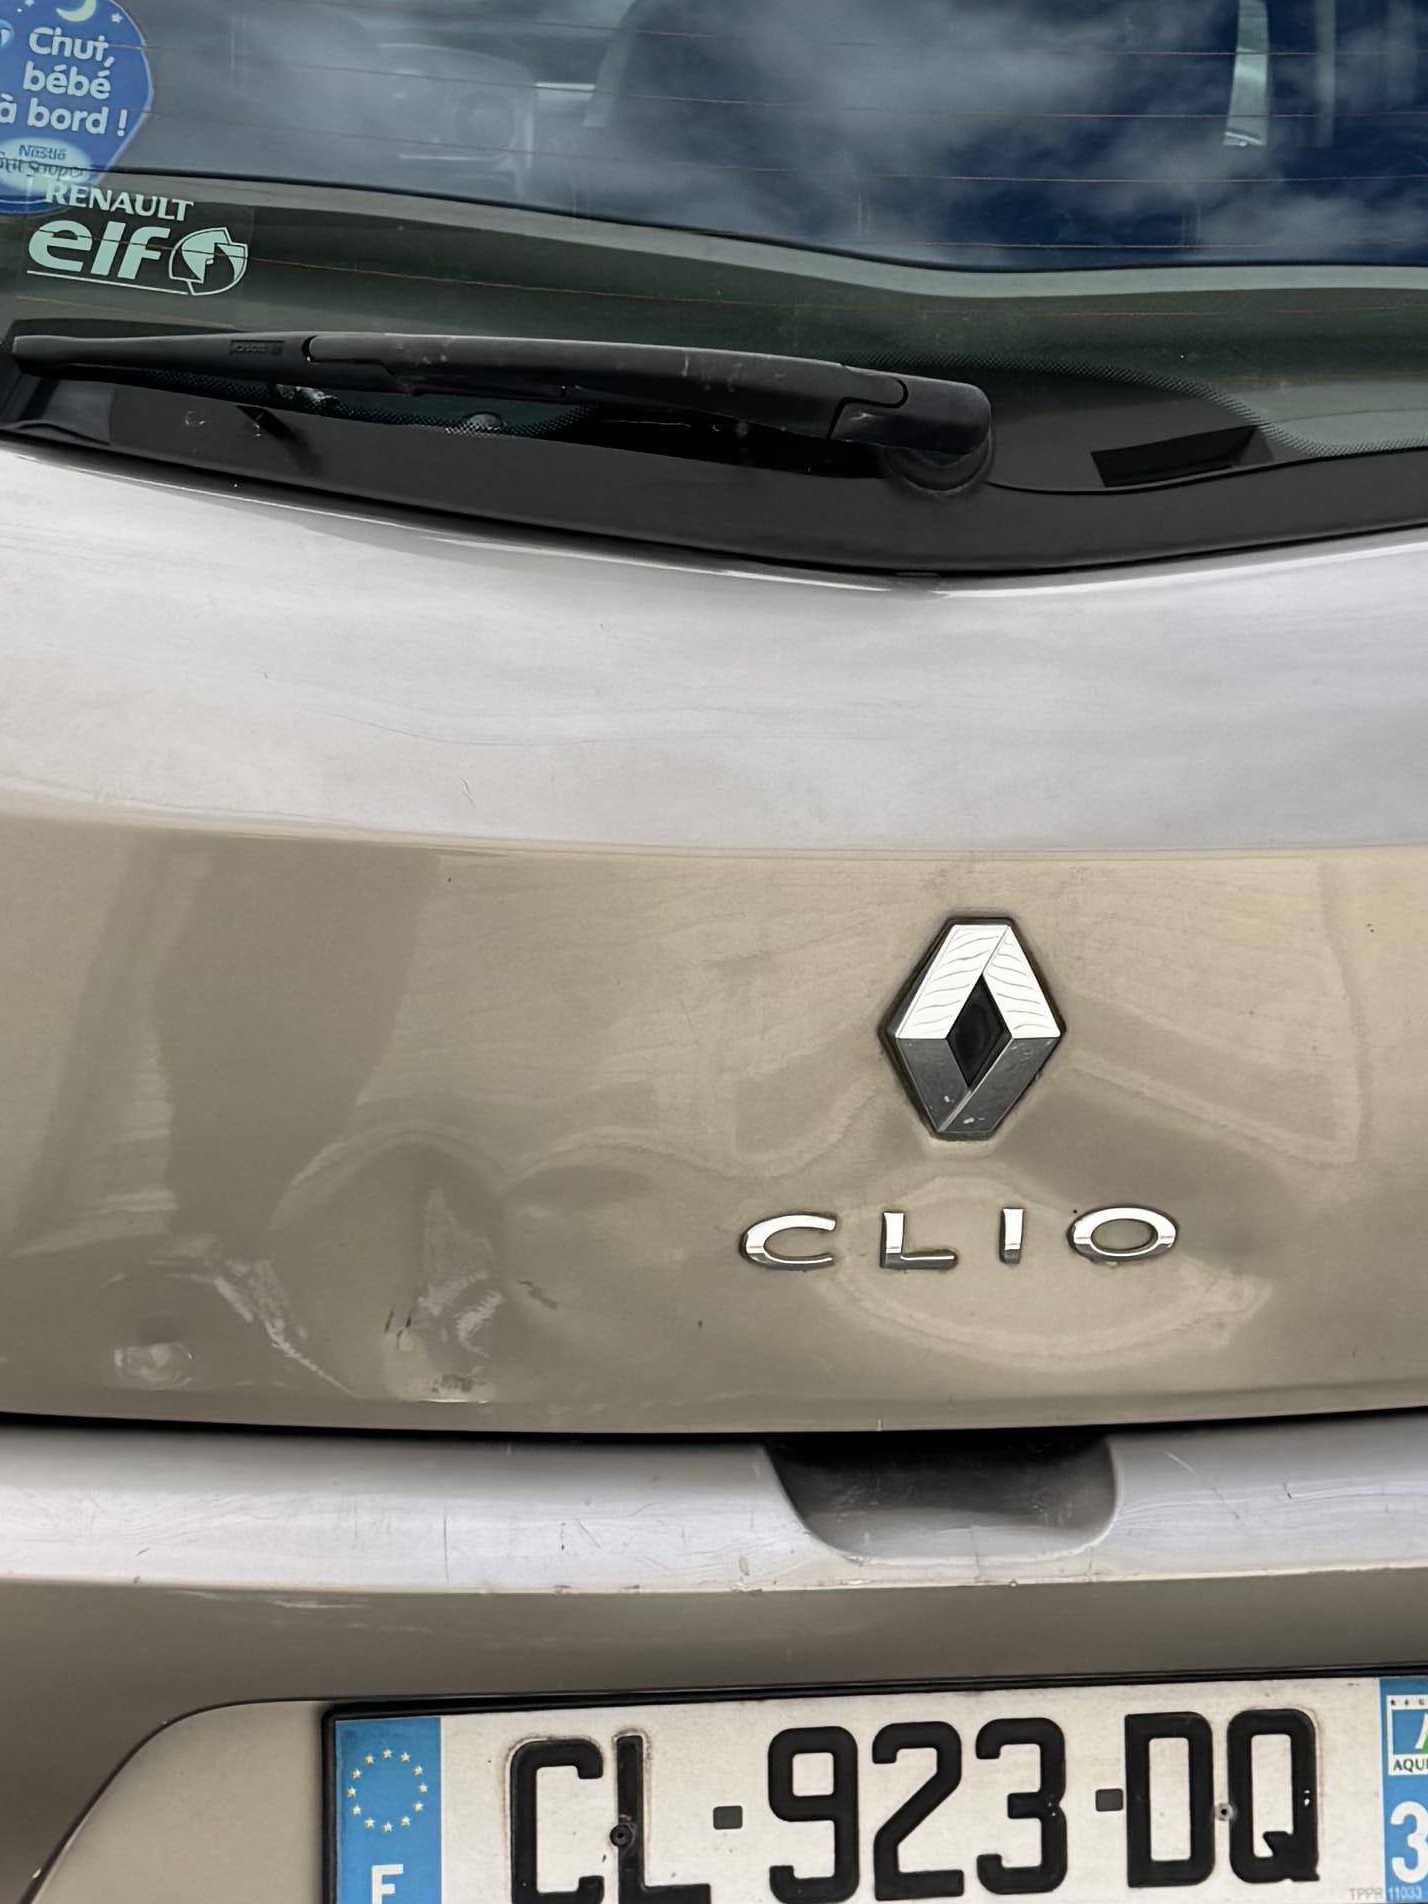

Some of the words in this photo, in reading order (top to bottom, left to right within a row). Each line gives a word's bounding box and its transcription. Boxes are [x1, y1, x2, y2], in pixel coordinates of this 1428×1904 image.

[29, 27, 115, 67] Chut,
[23, 60, 111, 99] bébé
[27, 97, 109, 134] bord
[44, 181, 194, 221] RENAULT
[28, 220, 171, 280] elf
[739, 1207, 1179, 1271] CLIO
